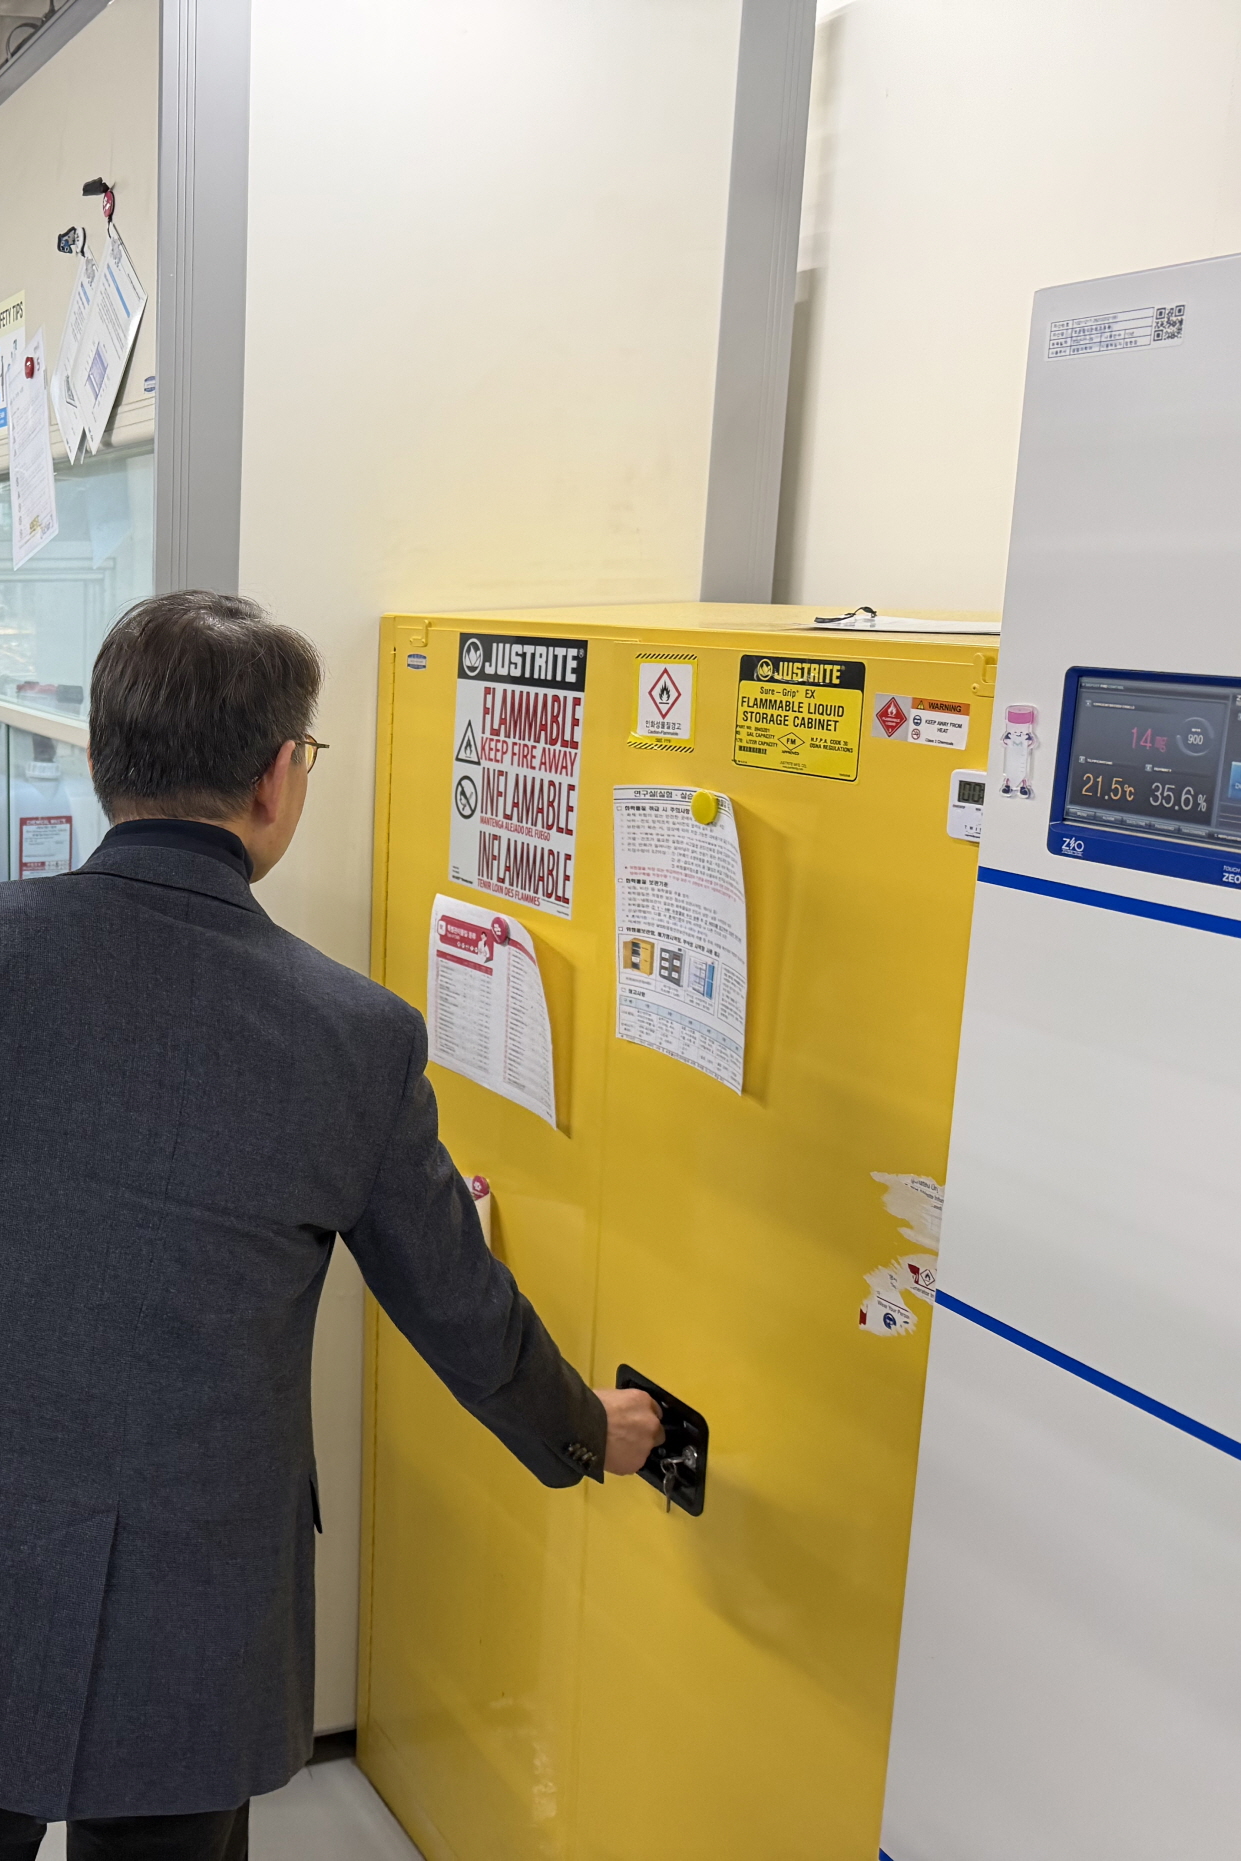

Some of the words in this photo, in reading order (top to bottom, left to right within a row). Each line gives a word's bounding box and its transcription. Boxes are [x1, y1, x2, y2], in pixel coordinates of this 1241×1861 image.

[13, 301, 23, 322] TIPS
[485, 643, 578, 683] JUSTRITE
[774, 662, 841, 684] JUSTRITE
[805, 689, 816, 699] EX
[741, 696, 804, 714] FLAMMABLE
[808, 703, 845, 718] LIQUID
[929, 702, 962, 713] WARNING
[482, 687, 581, 750] FLAMMABLE
[743, 711, 789, 727] STORAGE
[793, 717, 839, 732] CABINET
[823, 744, 853, 753] REGULATIONS
[1131, 727, 1153, 750] 14
[1187, 734, 1204, 745] 900
[481, 736, 509, 764] KEEP
[511, 742, 537, 770] FIRE
[539, 747, 578, 777] AWAY
[481, 767, 576, 836] INFLAMABLE
[480, 816, 504, 829] MANTENGA
[505, 822, 524, 835] ALEJADO
[525, 827, 533, 838] DEL
[535, 829, 551, 841] FUEGO
[478, 831, 572, 905] INFLAMMABLE
[478, 878, 492, 891] TENIR
[492, 882, 504, 894] LOIN
[504, 886, 514, 898] DES
[515, 890, 540, 907] FLAMMES
